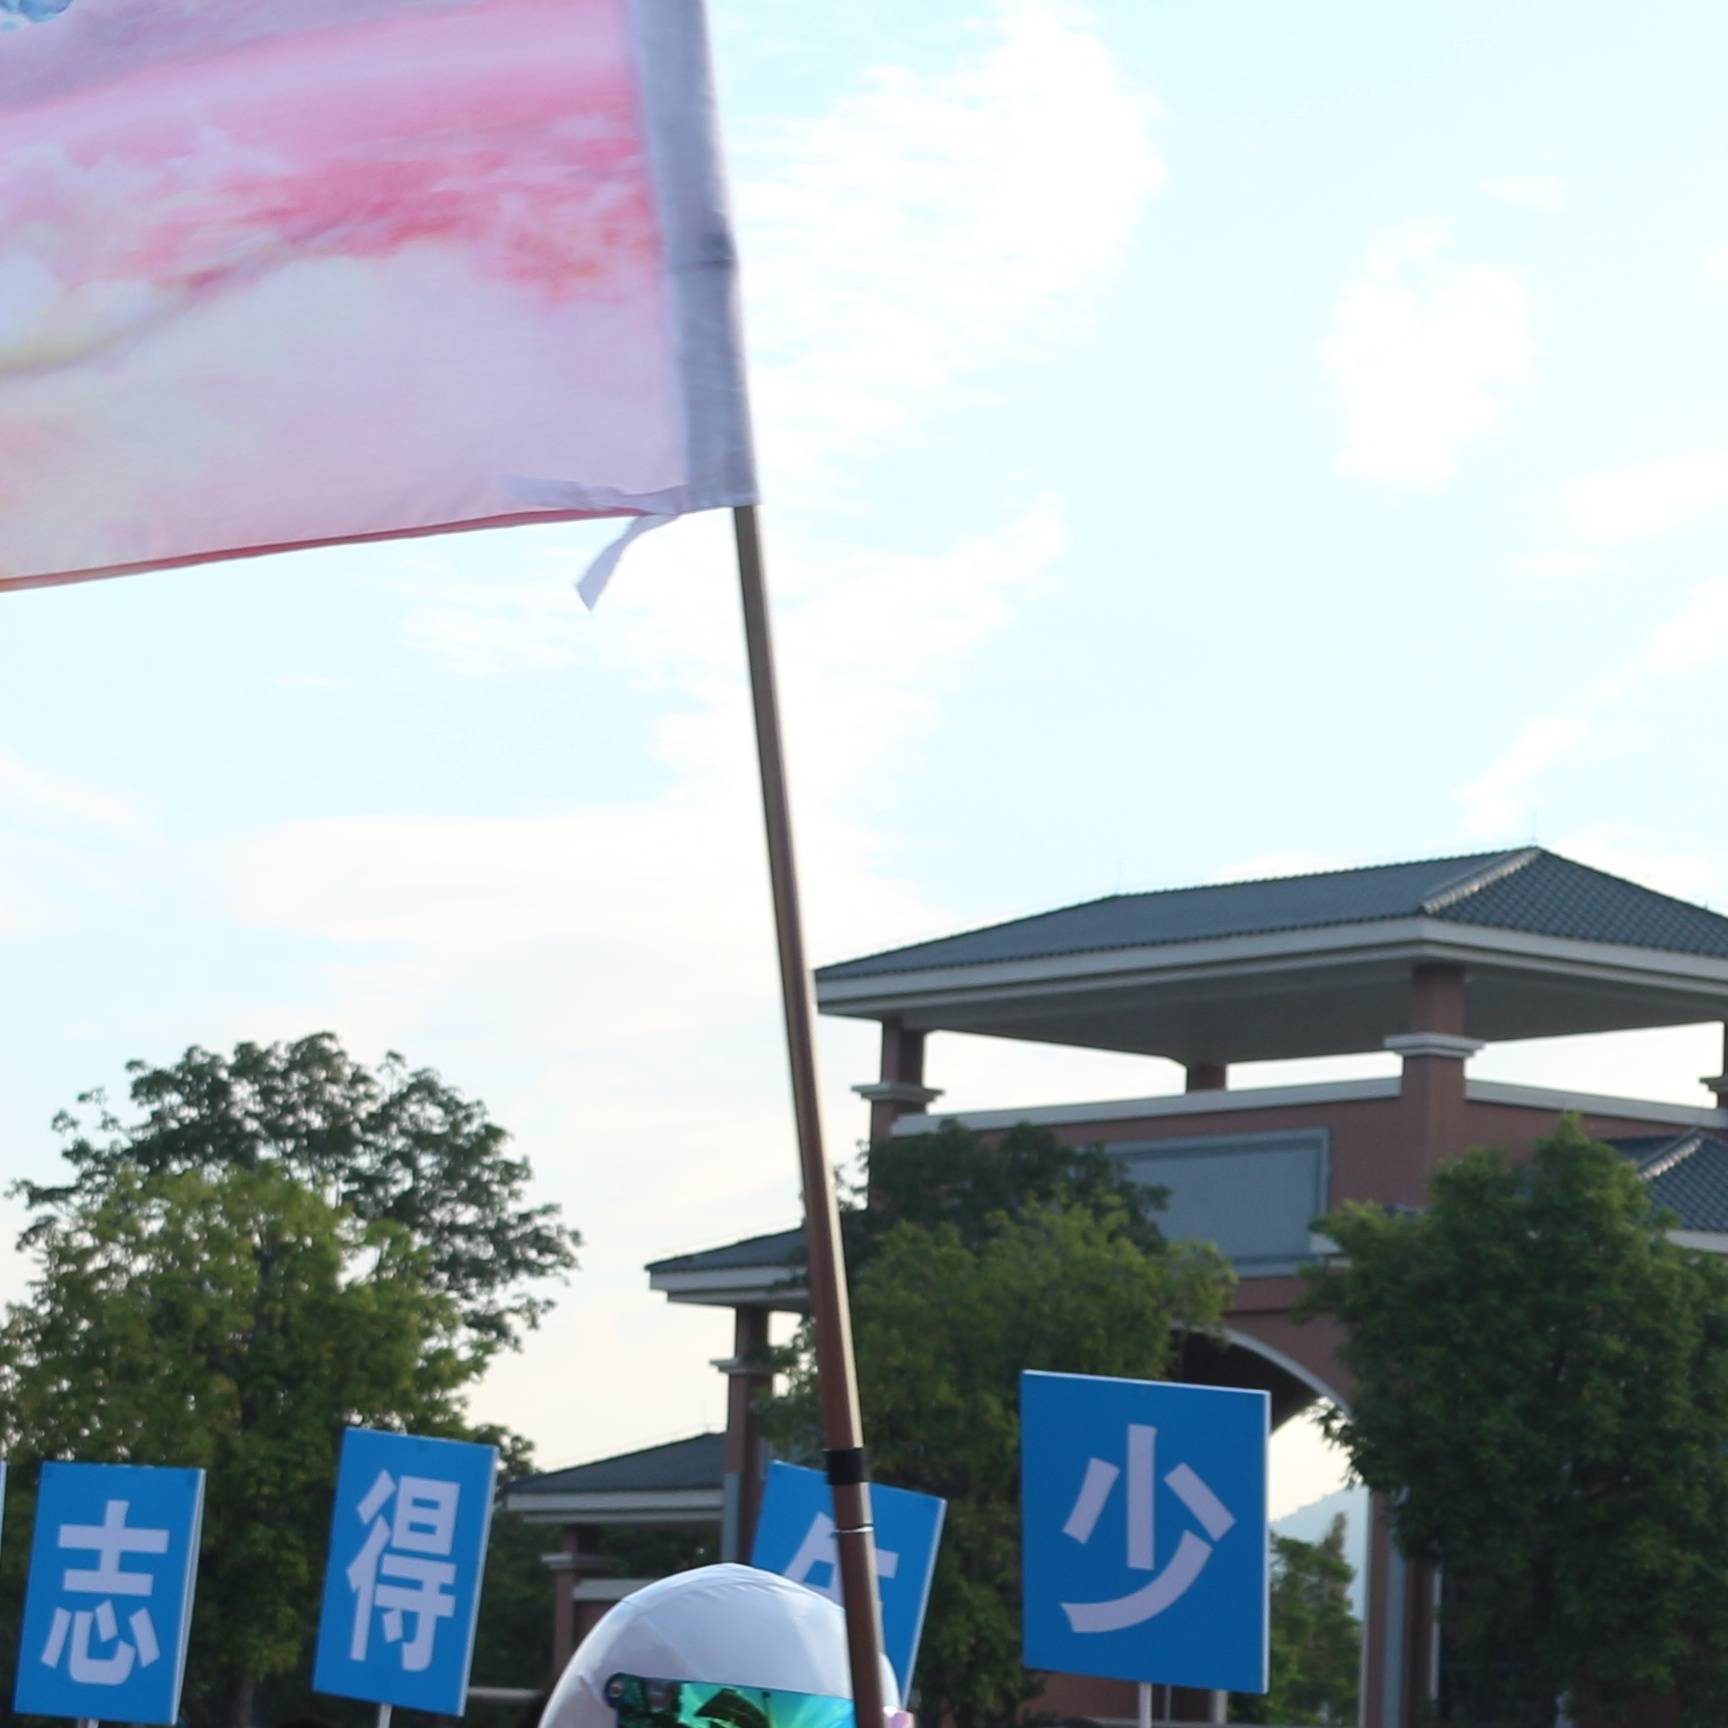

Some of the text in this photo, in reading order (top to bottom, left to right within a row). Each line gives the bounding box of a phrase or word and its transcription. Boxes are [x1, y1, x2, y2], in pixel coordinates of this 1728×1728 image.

[40, 1499, 171, 1686] 志
[346, 1469, 461, 1672] 得
[1060, 1423, 1238, 1634] 少
